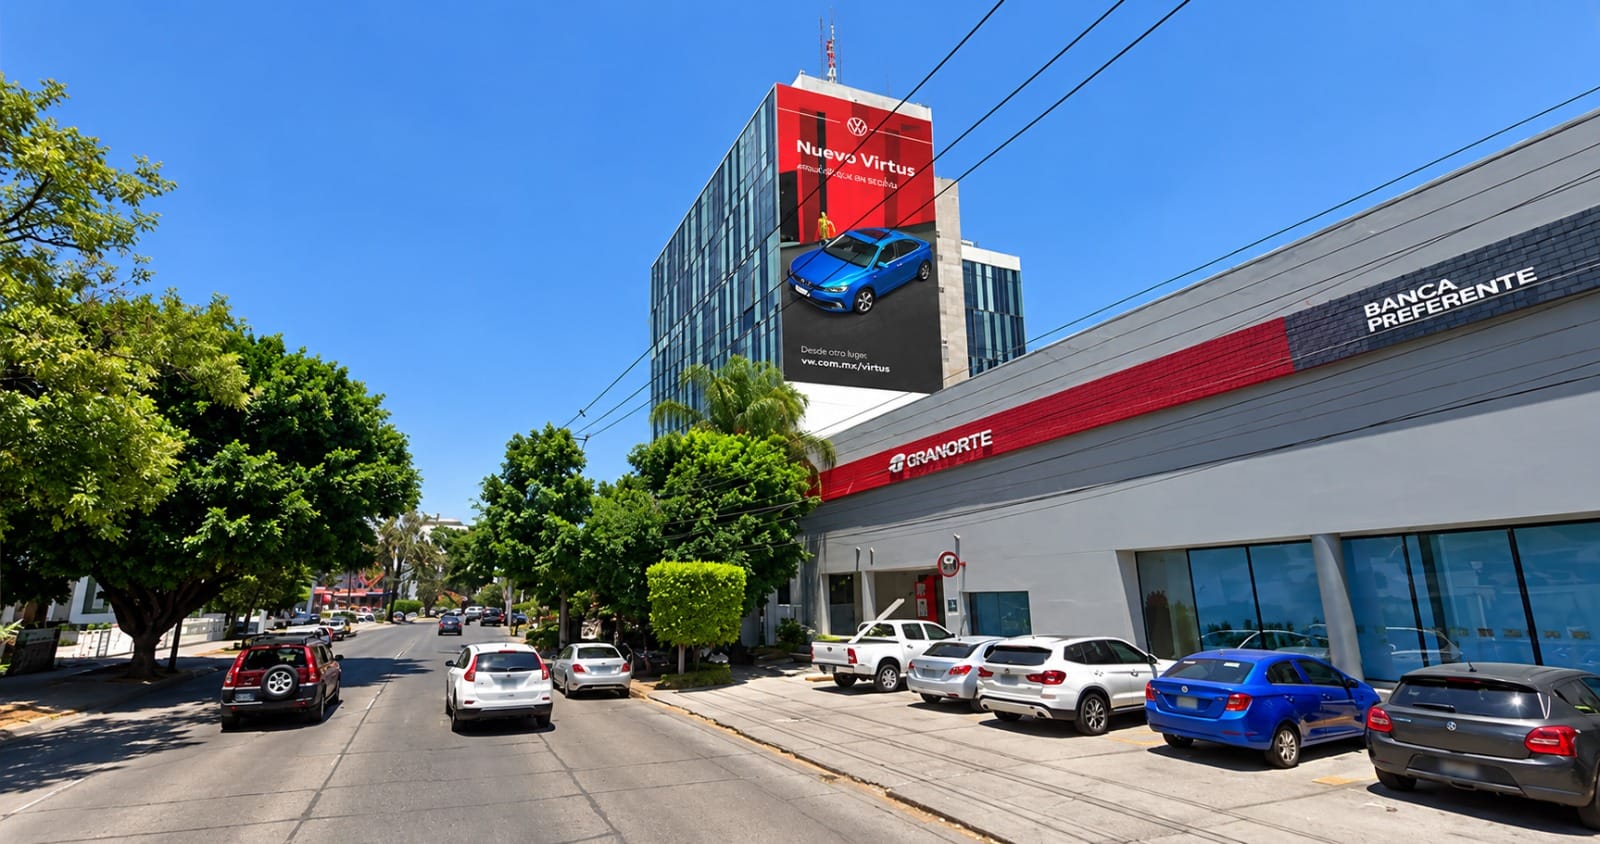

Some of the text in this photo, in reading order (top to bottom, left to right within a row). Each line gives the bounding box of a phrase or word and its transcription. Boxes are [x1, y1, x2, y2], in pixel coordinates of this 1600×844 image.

[797, 140, 856, 164] Nuevo
[860, 153, 916, 177] Virtus
[1364, 278, 1458, 318] BANCA
[1368, 266, 1538, 332] PREFERENTE
[801, 345, 827, 355] Desde
[828, 349, 846, 357] otro
[801, 358, 890, 373] vw.com.mx/virtus
